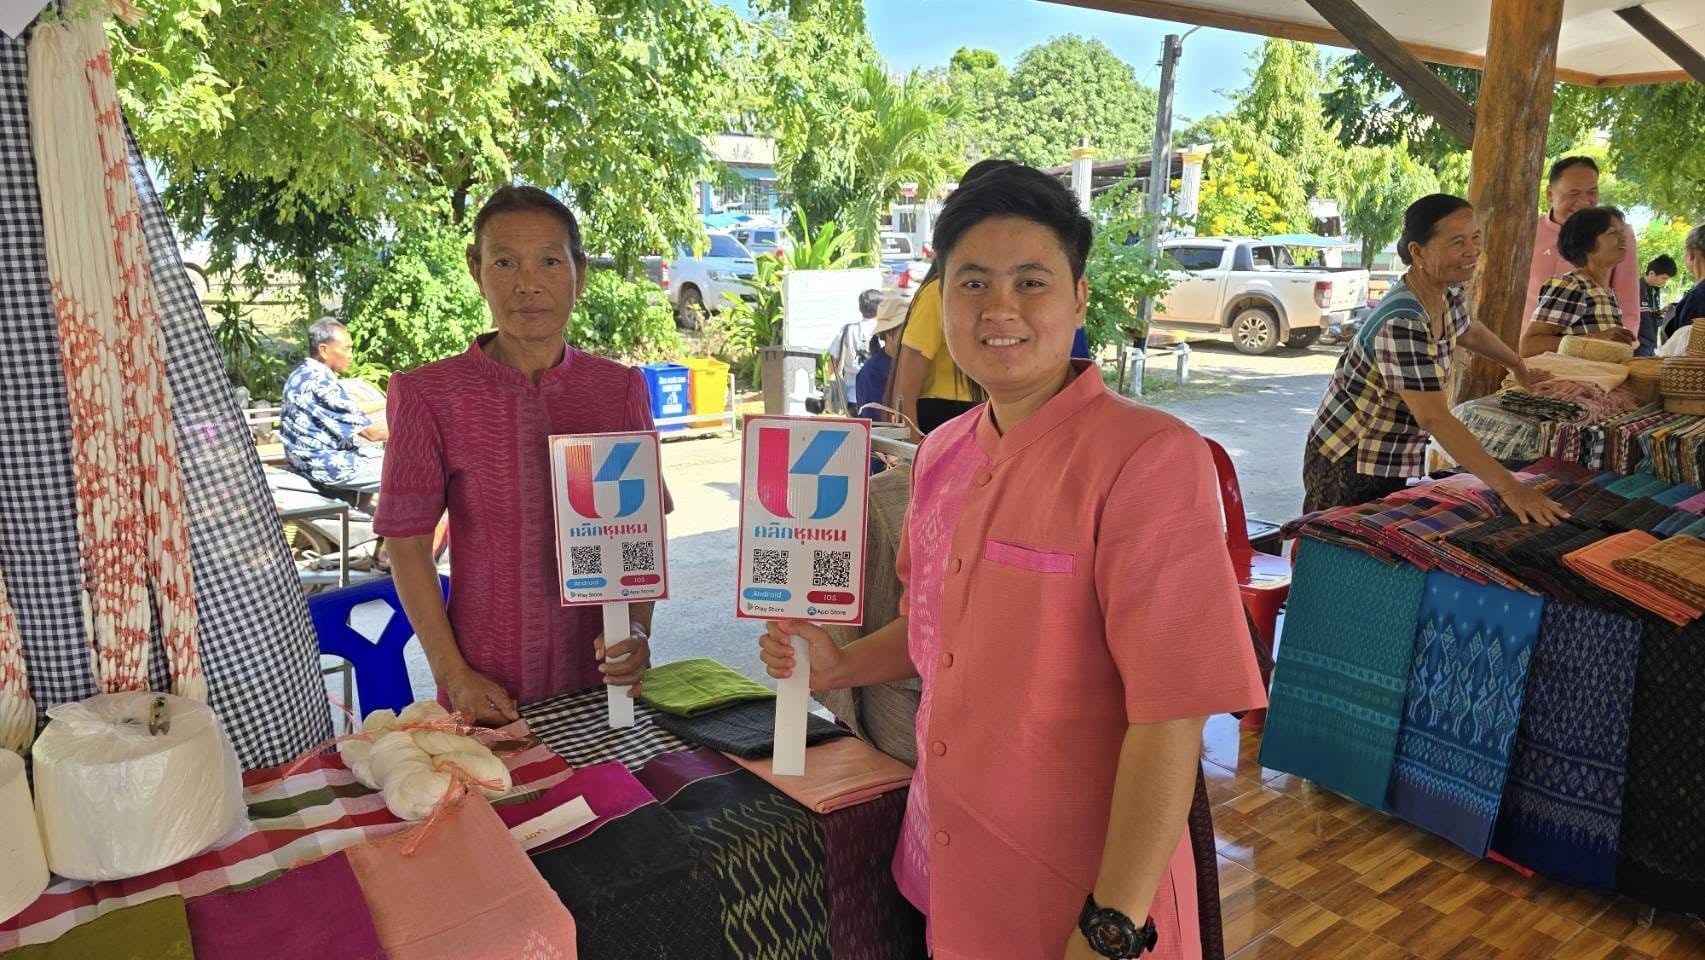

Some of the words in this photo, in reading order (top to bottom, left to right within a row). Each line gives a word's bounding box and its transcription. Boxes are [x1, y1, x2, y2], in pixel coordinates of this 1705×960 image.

[570, 523, 648, 540] คลิกชุมชน
[754, 522, 847, 545] คลิกชุมชน
[754, 605, 767, 613] Play
